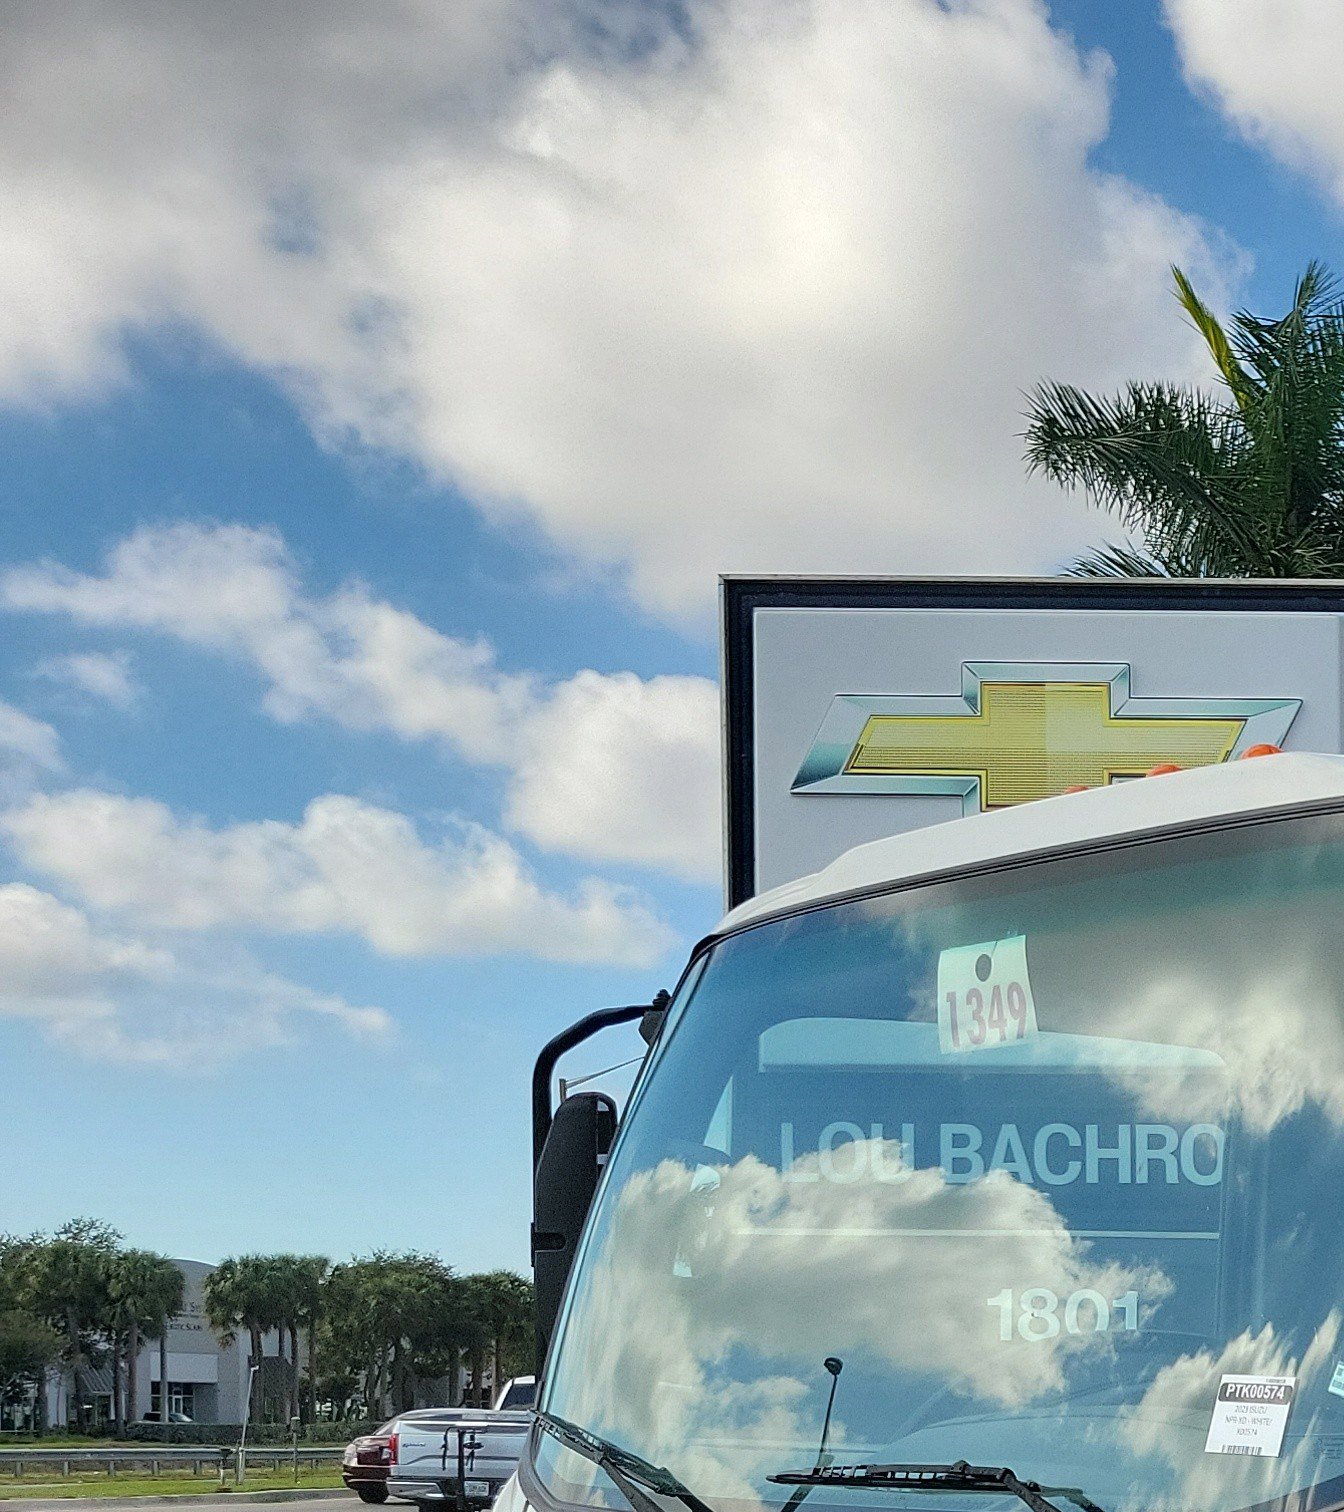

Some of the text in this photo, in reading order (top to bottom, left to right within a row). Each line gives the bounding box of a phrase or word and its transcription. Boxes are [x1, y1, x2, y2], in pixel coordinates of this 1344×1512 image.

[945, 981, 1027, 1048] 1349
[779, 1120, 1226, 1187] LOU BACHRO
[987, 1287, 1139, 1343] 1801
[1225, 1384, 1286, 1400] PTK00574
